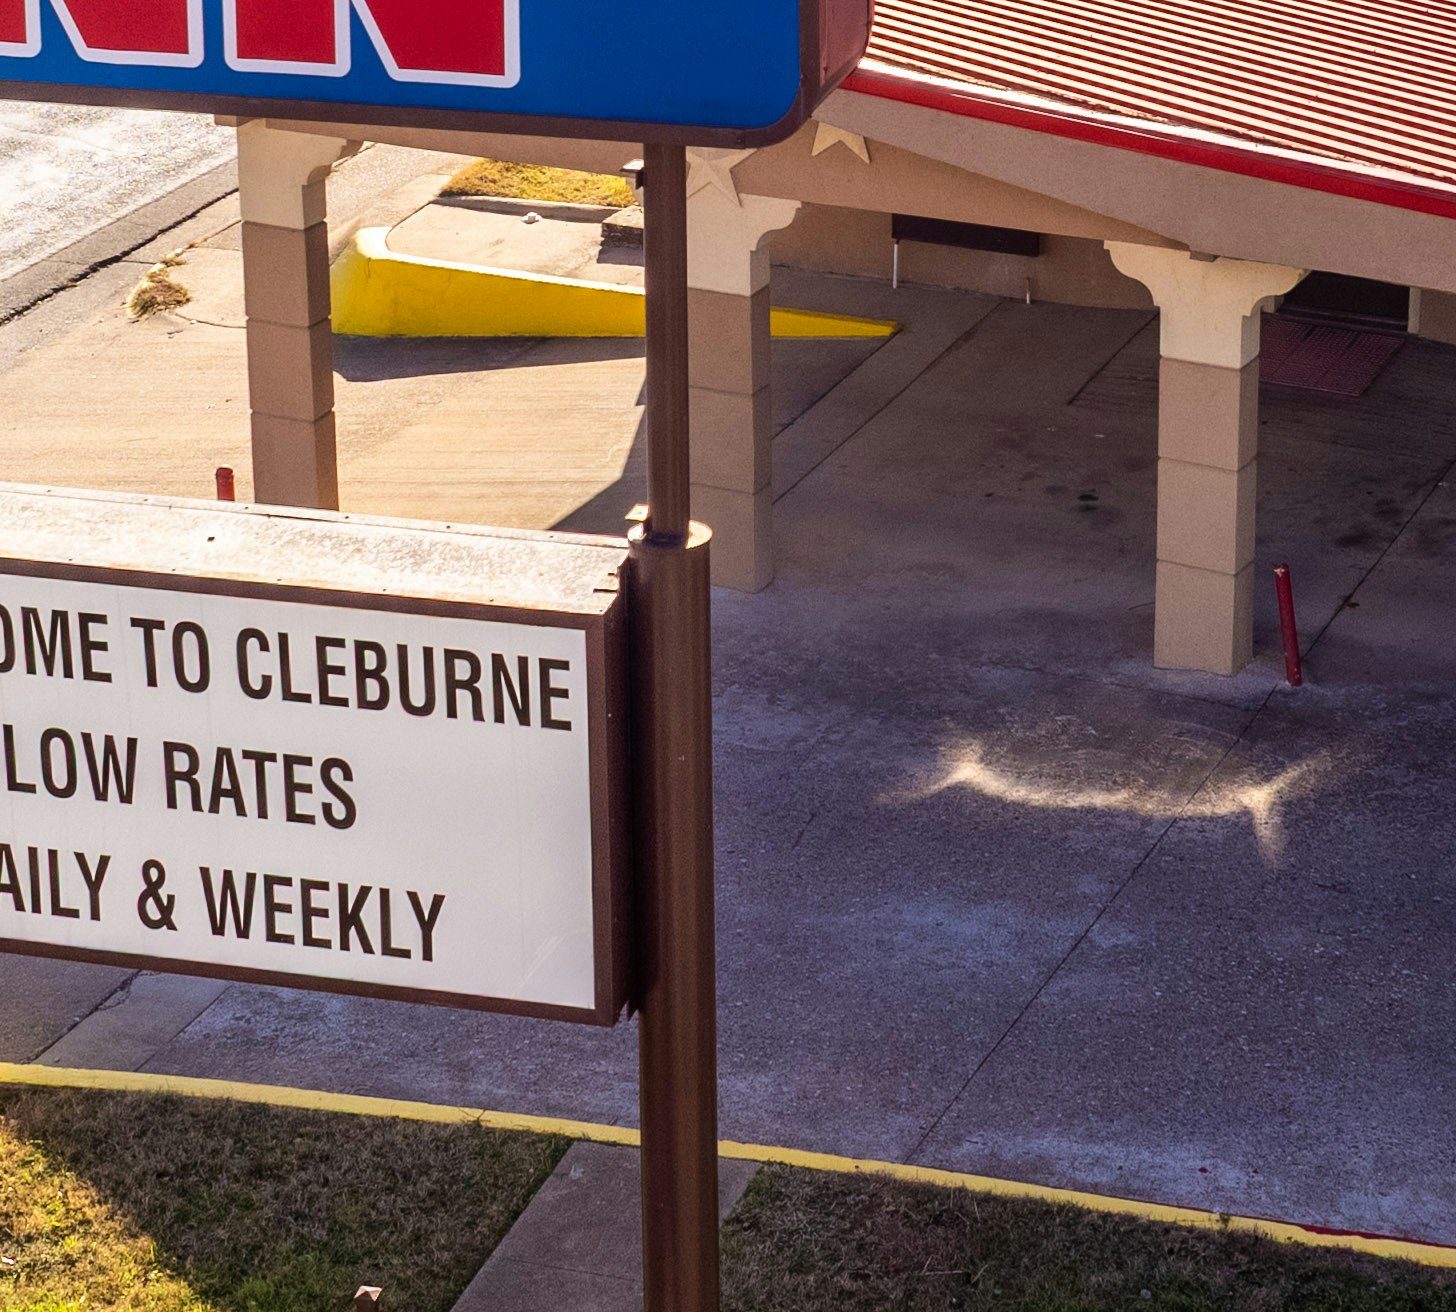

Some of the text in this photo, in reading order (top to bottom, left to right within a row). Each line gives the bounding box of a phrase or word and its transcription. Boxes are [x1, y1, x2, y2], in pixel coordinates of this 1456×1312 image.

[130, 616, 211, 694] TO
[236, 627, 573, 732] CLEBURNE
[2, 723, 358, 830] LOW RATES
[137, 857, 178, 933] &
[199, 865, 447, 963] WEEKLY
